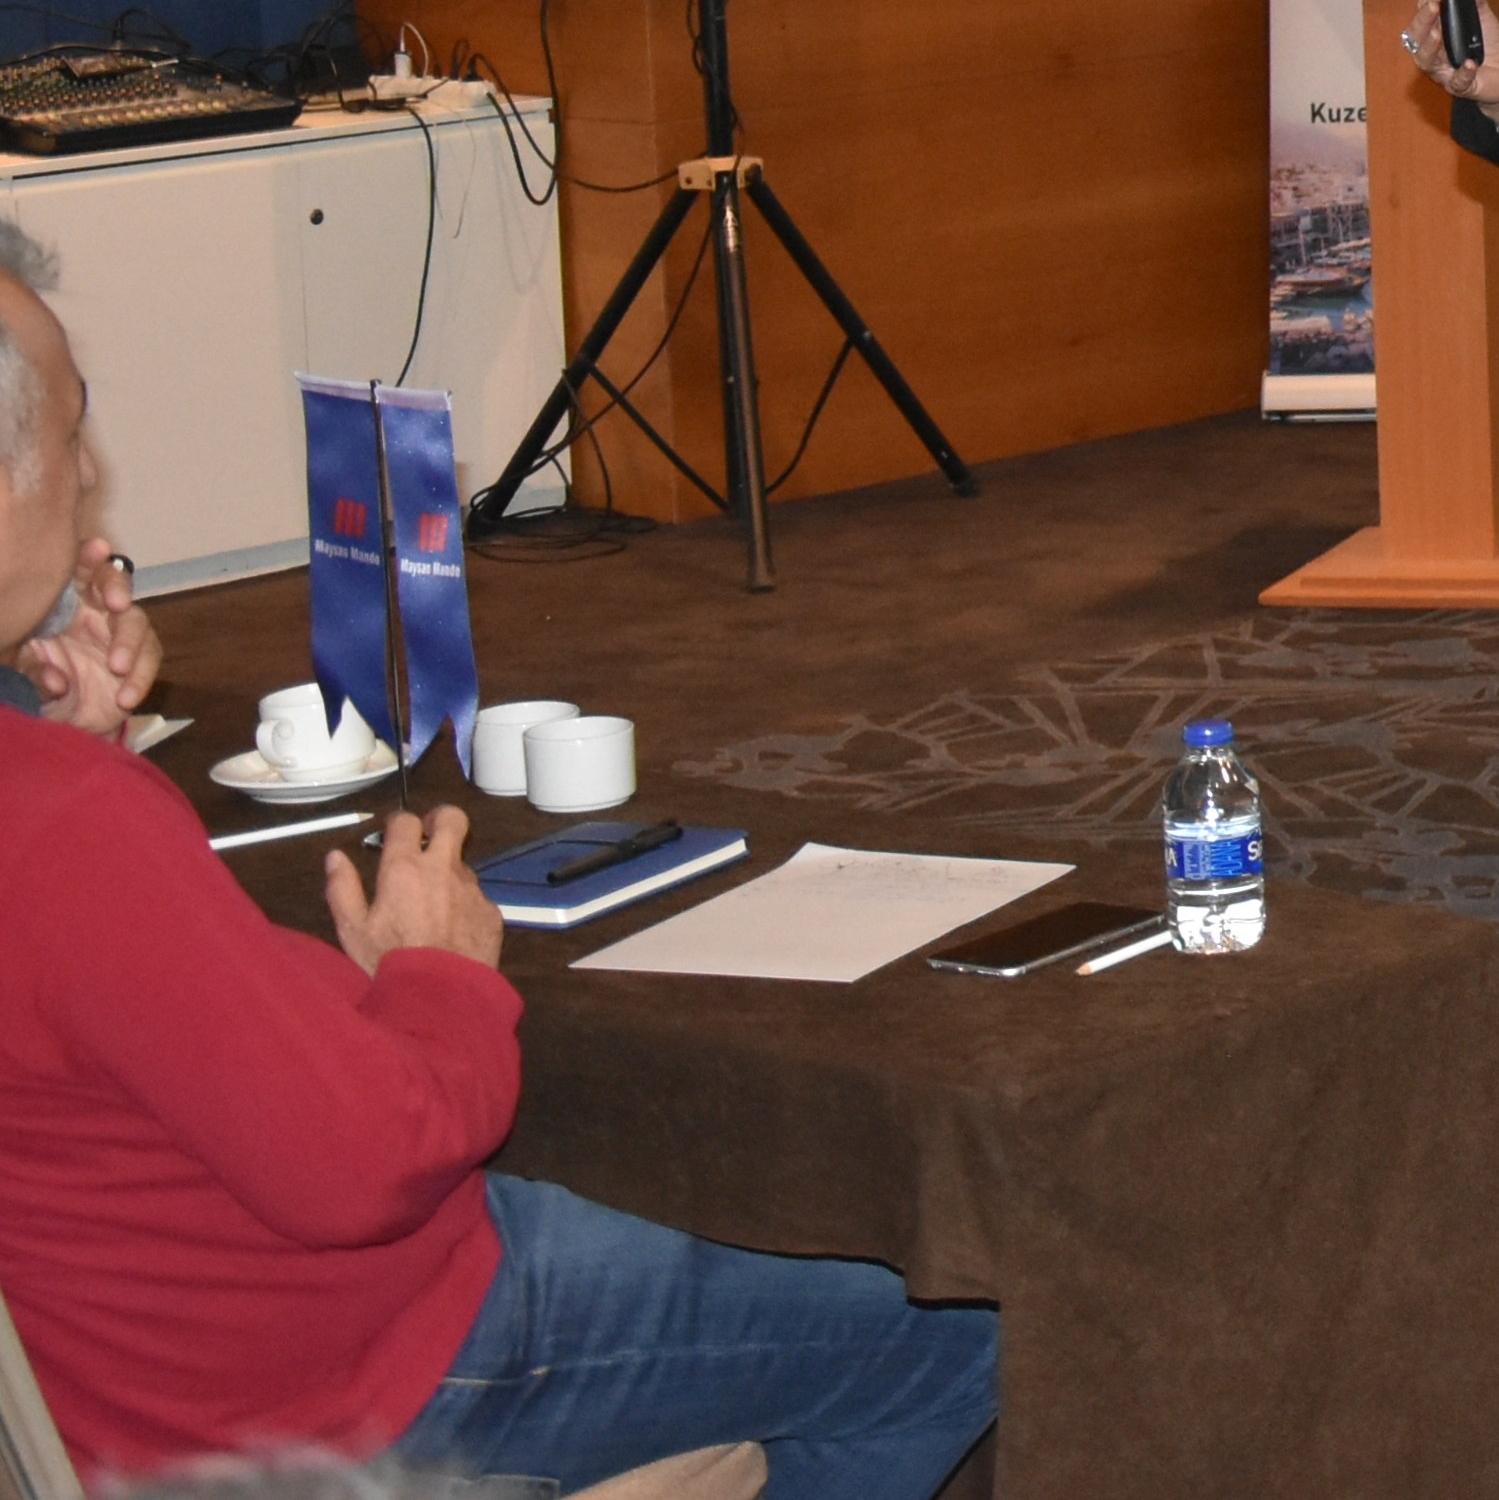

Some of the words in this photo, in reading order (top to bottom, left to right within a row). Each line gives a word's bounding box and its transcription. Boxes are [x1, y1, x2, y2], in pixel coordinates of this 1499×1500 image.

[1310, 102, 1368, 124] Kuze
[400, 558, 432, 577] Maysan
[433, 560, 462, 578] Mando
